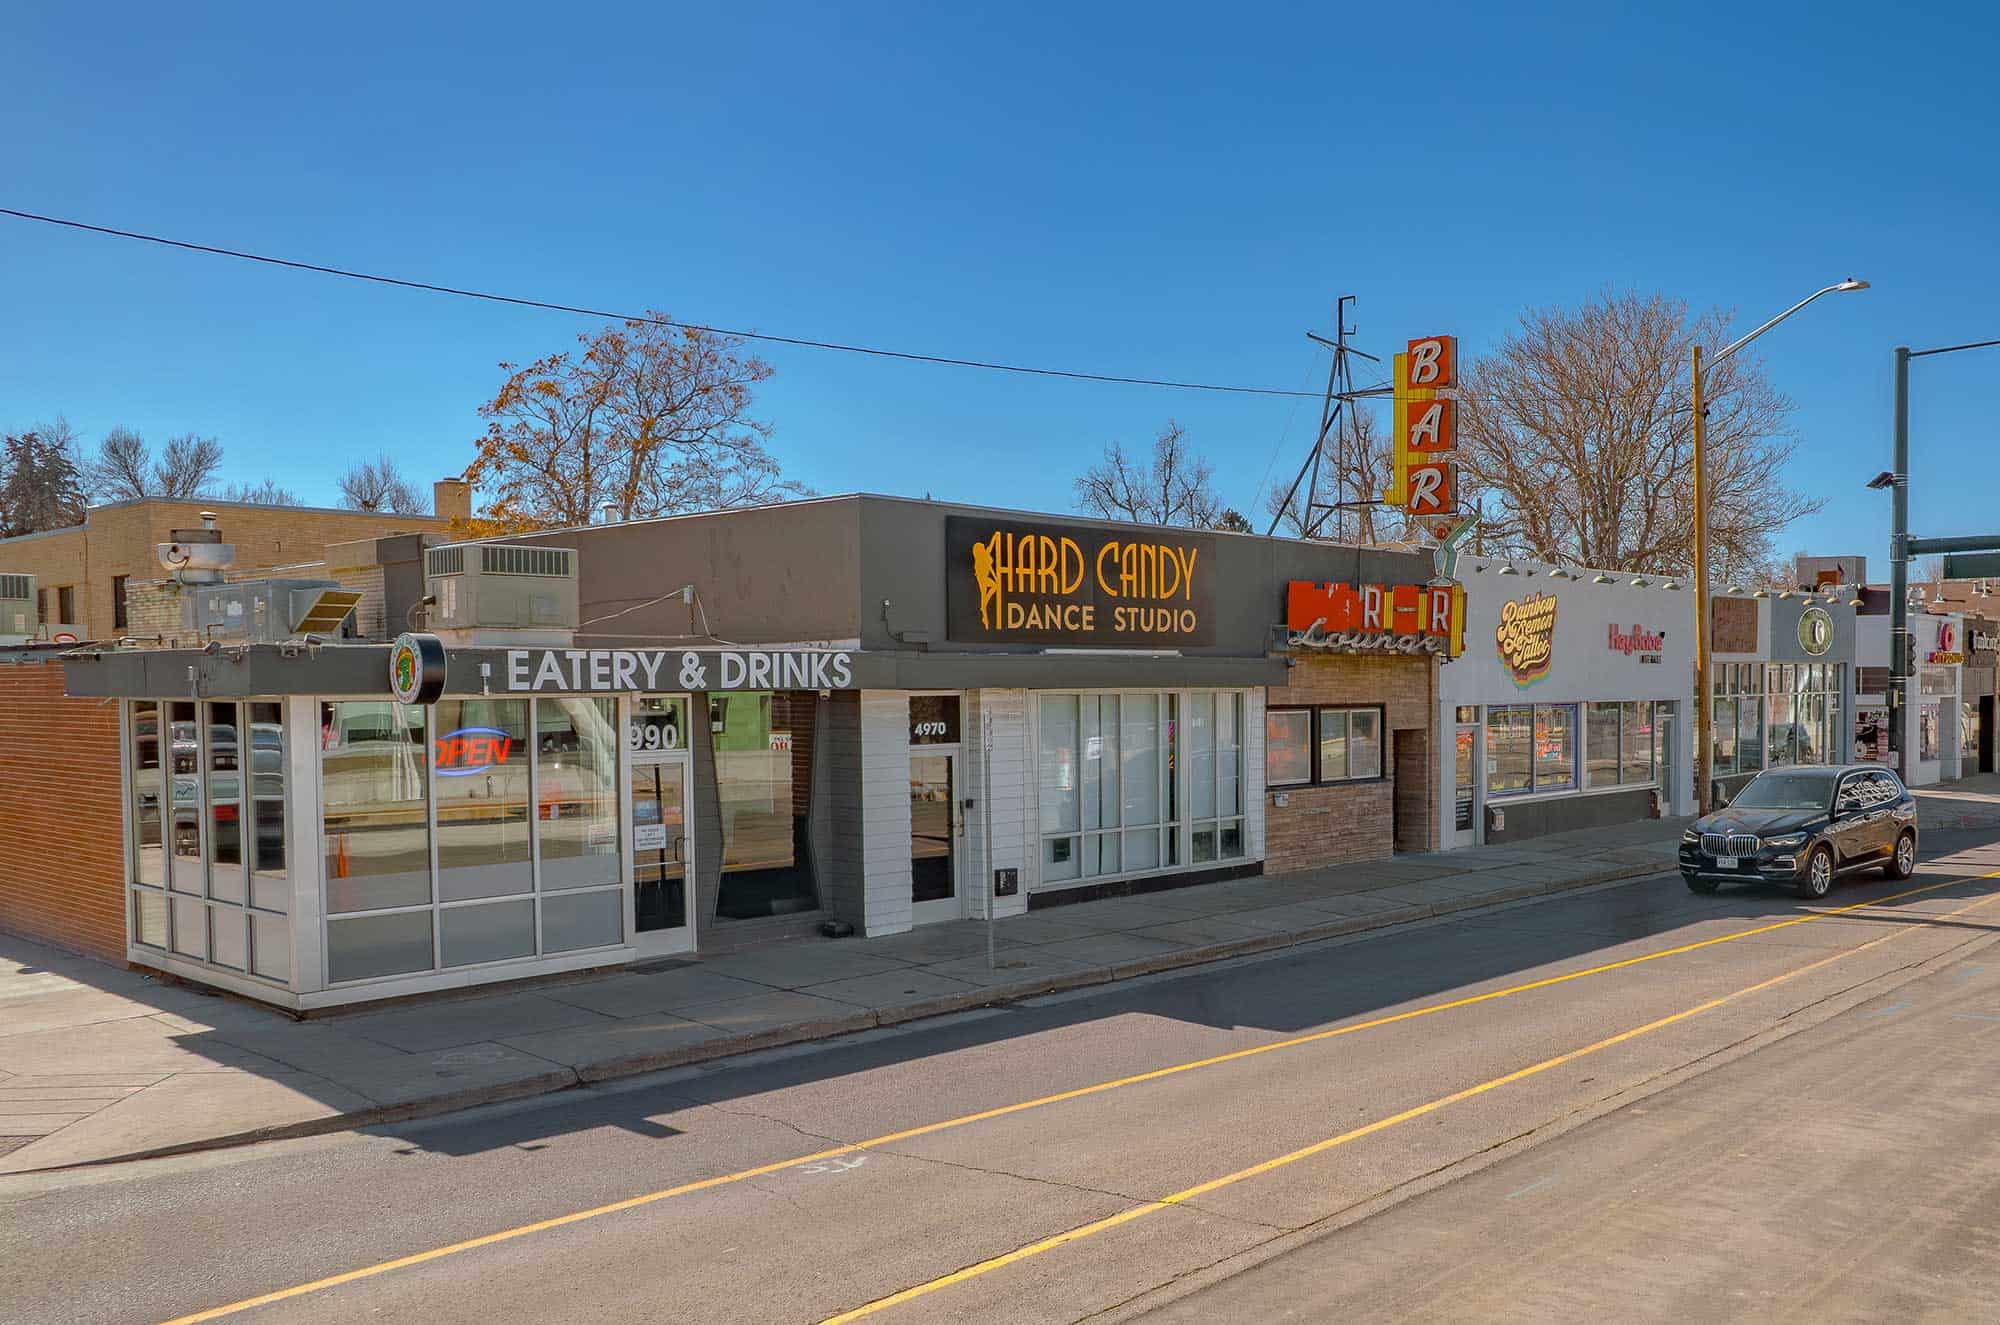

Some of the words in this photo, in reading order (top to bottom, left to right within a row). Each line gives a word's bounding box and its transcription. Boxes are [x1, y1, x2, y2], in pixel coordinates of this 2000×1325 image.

[1409, 340, 1444, 510] BAR
[995, 531, 1085, 596] HARD
[1096, 541, 1197, 601] CANDY
[1007, 602, 1095, 632] DANCE
[1113, 606, 1197, 633] STUDIO
[1500, 592, 1556, 632] Rainbow
[507, 650, 665, 691] EATERY
[679, 651, 706, 690] &
[720, 651, 851, 690] DRINKS
[914, 721, 947, 736] 4970
[421, 735, 513, 768] OPEN
